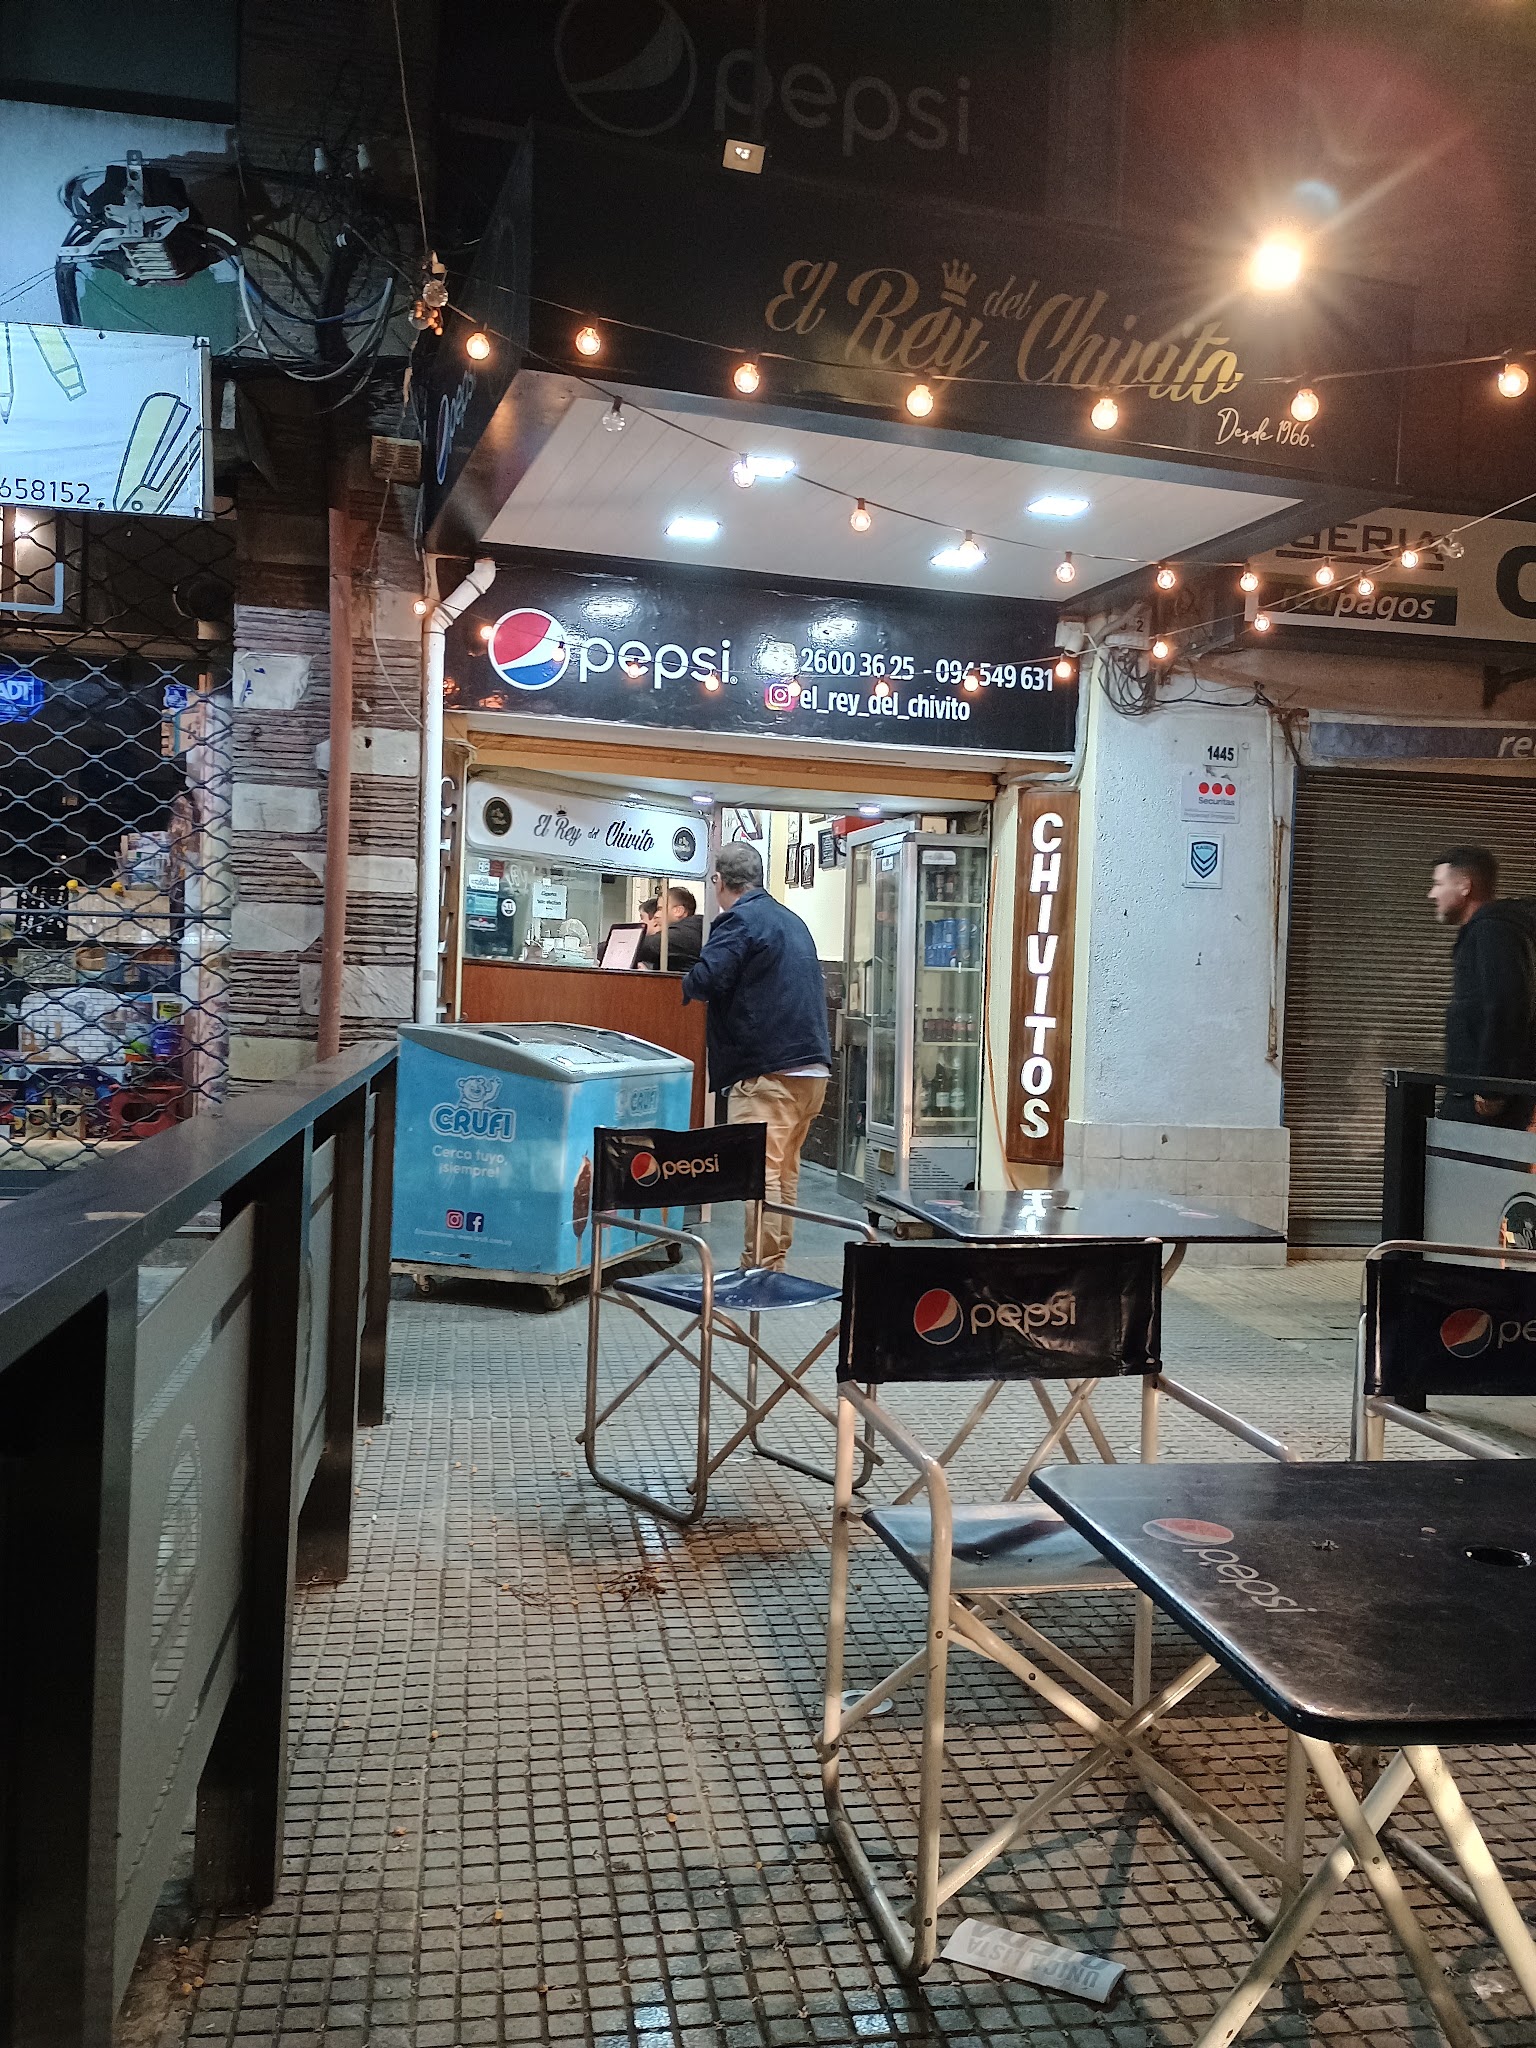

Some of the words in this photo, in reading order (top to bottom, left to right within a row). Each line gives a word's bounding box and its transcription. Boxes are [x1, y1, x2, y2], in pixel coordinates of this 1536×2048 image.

[713, 48, 971, 156] pepsi
[764, 259, 838, 335] El
[844, 268, 990, 394] Rey
[983, 276, 1039, 321] del
[1017, 289, 1244, 404] Chivito
[1215, 407, 1274, 446] Desde
[0, 477, 91, 504] 658152
[579, 636, 731, 690] pepsi
[800, 648, 855, 676] 2600
[859, 652, 886, 678] 36
[889, 656, 915, 681] 25
[979, 663, 1016, 689] 549
[1021, 667, 1053, 691] 631
[800, 685, 971, 721] el_rey_del_chivito
[1207, 745, 1235, 762] 1445
[1497, 736, 1536, 758] re
[534, 814, 553, 837] El
[555, 816, 583, 846] Rey
[605, 820, 655, 852] Chivito
[1020, 812, 1064, 1139] CHIVITOS
[434, 1107, 511, 1137] CRUFI
[432, 1145, 472, 1160] Cerca
[662, 1153, 719, 1181] pepsi
[971, 1294, 1077, 1335] pepsi
[1182, 1548, 1318, 1613] pepsi
